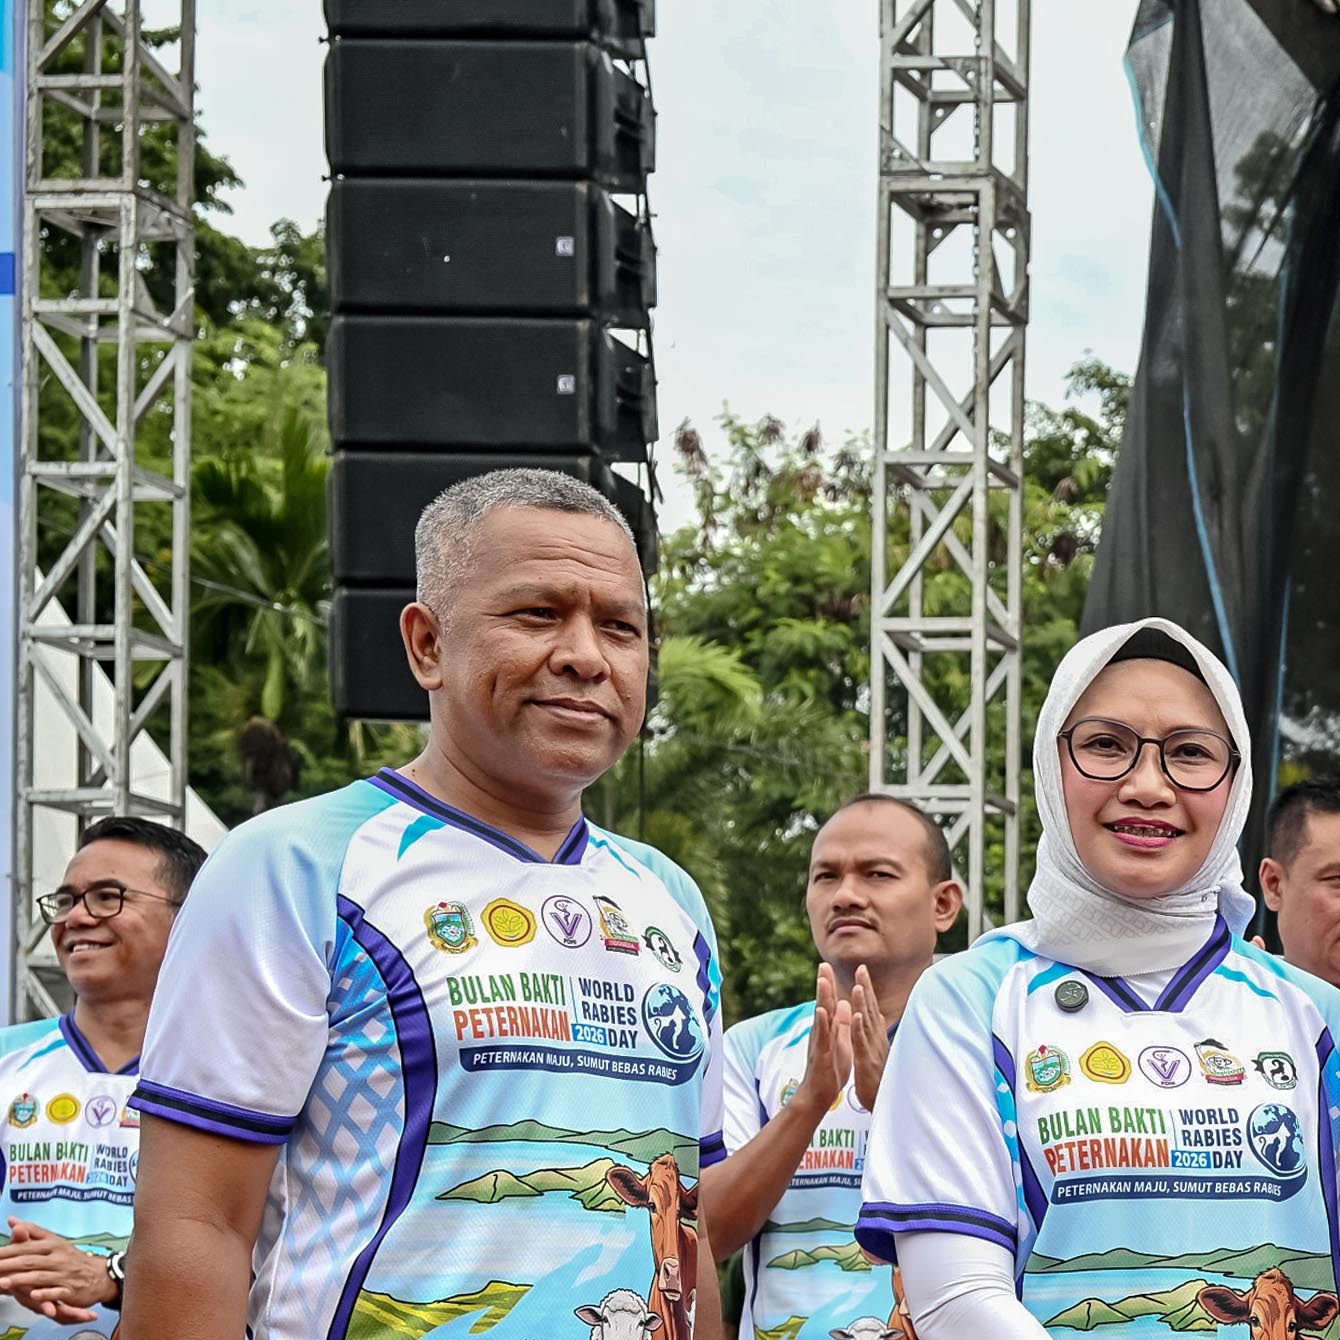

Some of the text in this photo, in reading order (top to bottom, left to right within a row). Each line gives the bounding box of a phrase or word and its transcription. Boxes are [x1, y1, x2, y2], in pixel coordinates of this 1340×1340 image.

[446, 971, 567, 1007] BULAN BAKTI
[578, 976, 635, 1003] WORLD
[454, 1005, 571, 1042] PETERNAKAN
[582, 1004, 637, 1026] RABIES
[576, 1026, 638, 1049] 2026 DAY
[472, 1050, 678, 1081] PETERNAKAN MAJU, SUMUT BEBAS RABIES
[1038, 1105, 1167, 1145] BULAN BAKTI
[1179, 1108, 1240, 1126] WORLD
[820, 1128, 855, 1149] BAKTI
[1183, 1127, 1242, 1147] RABIES
[9, 1142, 51, 1162] BULAN
[95, 1143, 128, 1159] WORLD
[800, 1149, 854, 1170] RNAKAN
[1044, 1136, 1170, 1177] PETERNAKAN
[1174, 1150, 1243, 1169] 2026 DAY
[94, 1157, 128, 1173] RABIES
[109, 1174, 128, 1187] DAY
[791, 1176, 828, 1187] TERNAKAN
[1057, 1180, 1282, 1198] PETERNAKAN MAJU, SUMUT BEBAS RABIES
